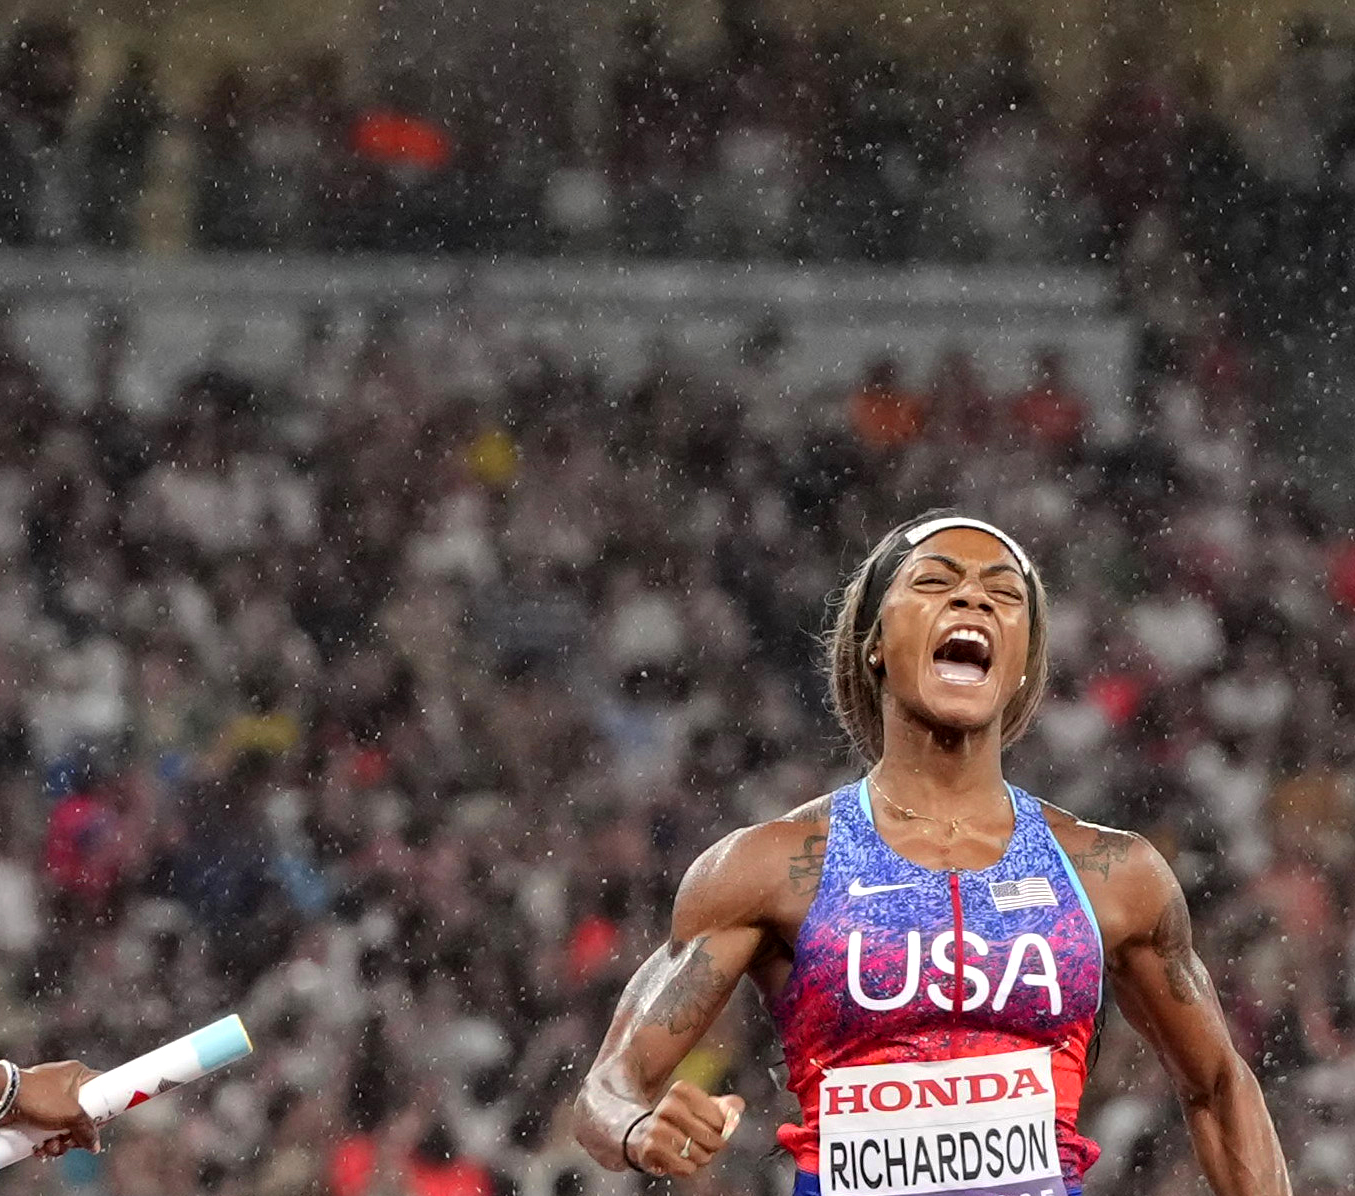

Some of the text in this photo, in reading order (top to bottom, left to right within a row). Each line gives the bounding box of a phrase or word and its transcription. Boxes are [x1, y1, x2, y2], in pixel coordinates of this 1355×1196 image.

[847, 931, 1062, 1016] USA
[825, 1067, 1049, 1116] HONDA
[830, 1120, 1049, 1191] RICHARDSON
